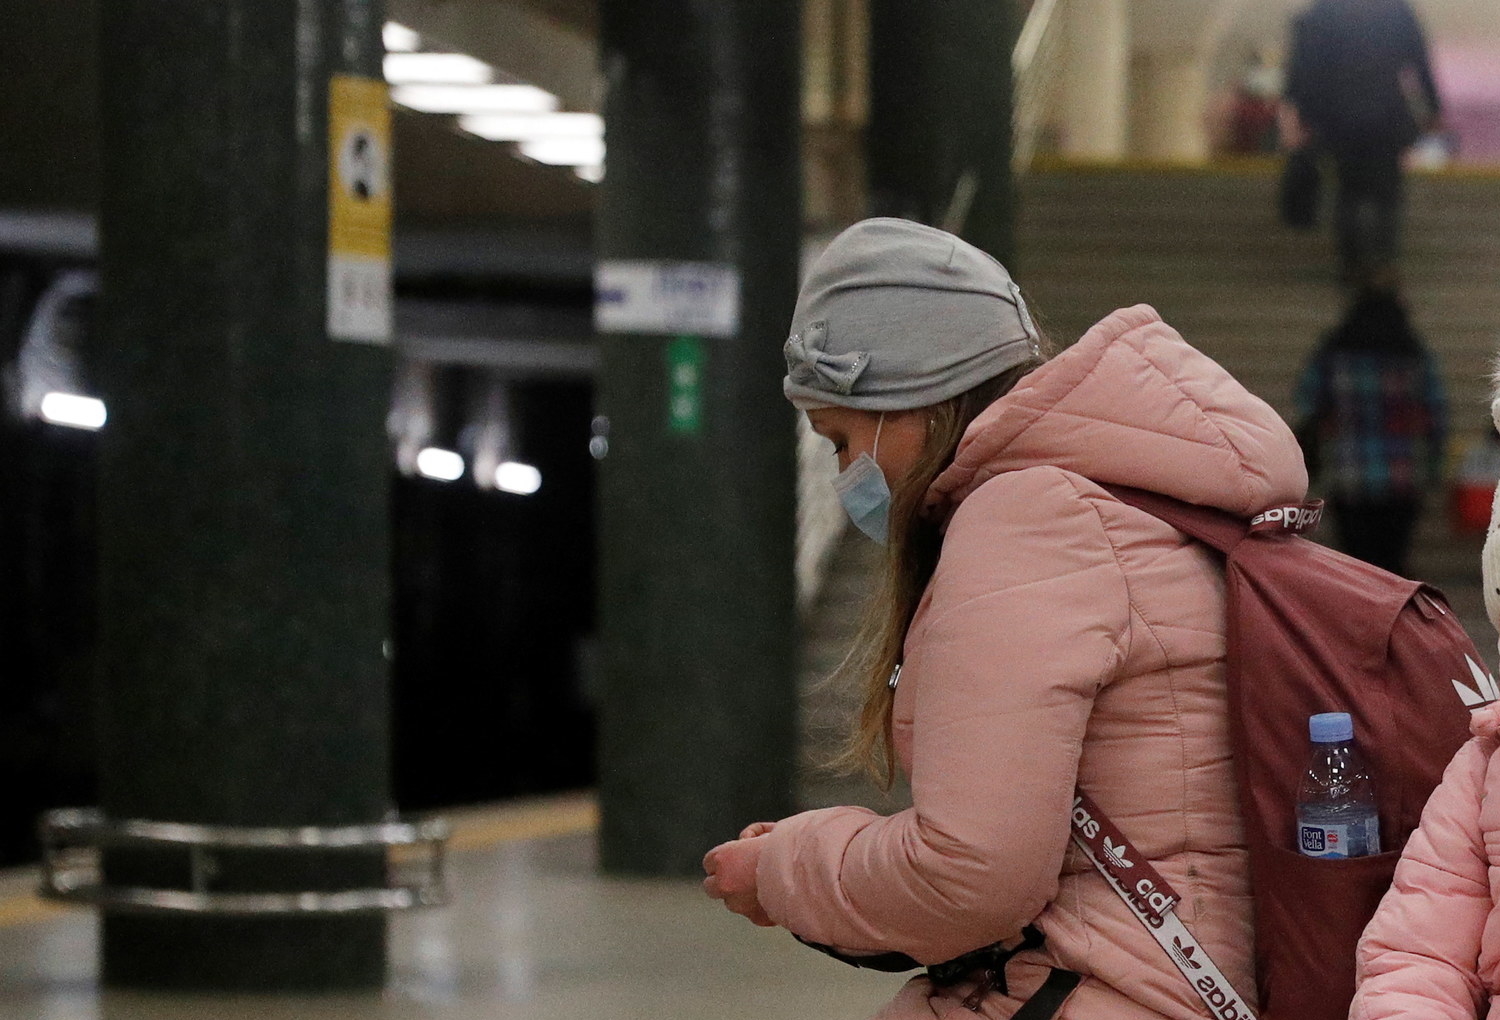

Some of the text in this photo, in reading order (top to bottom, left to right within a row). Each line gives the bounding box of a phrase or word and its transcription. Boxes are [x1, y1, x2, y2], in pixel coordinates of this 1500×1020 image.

[1251, 507, 1319, 529] adidas
[1302, 828, 1322, 840] Font
[1302, 839, 1323, 850] Vella
